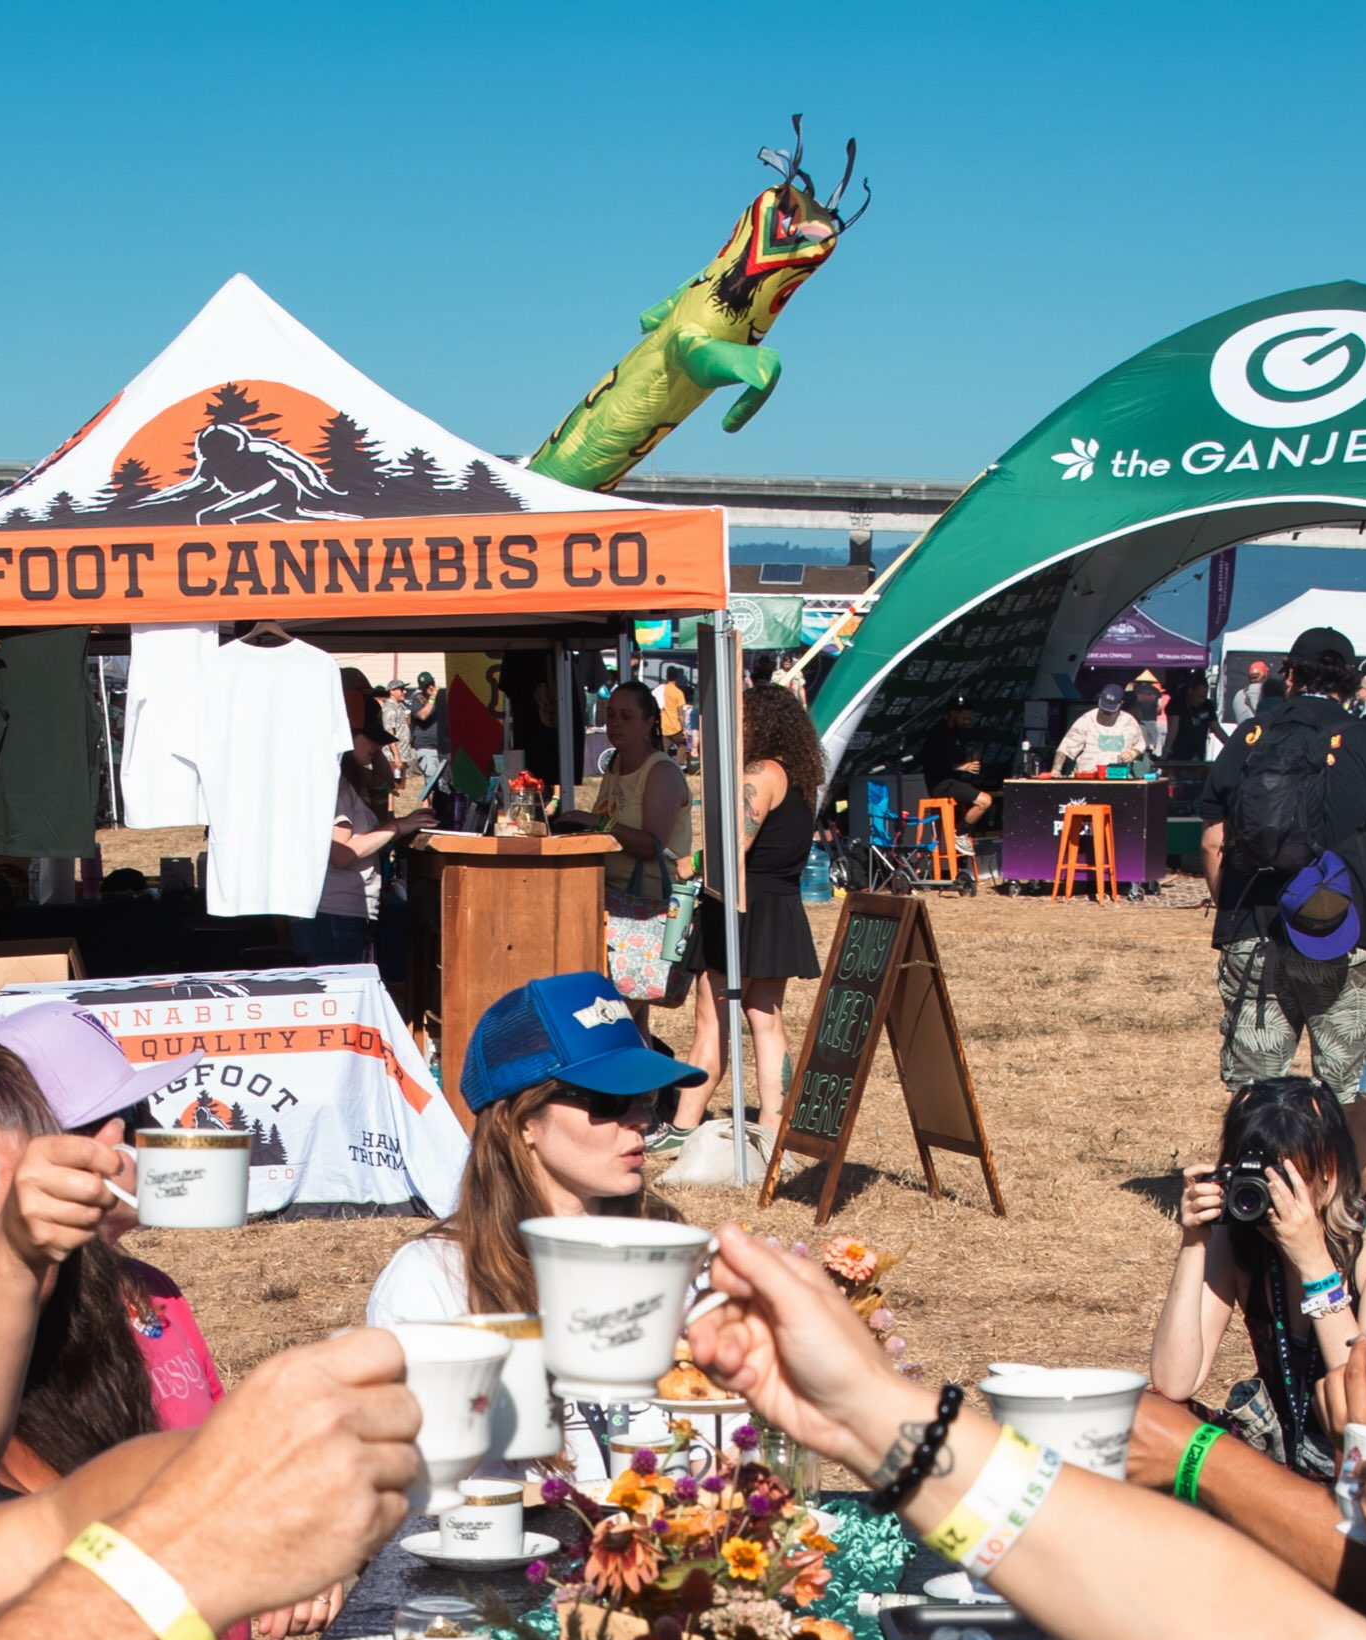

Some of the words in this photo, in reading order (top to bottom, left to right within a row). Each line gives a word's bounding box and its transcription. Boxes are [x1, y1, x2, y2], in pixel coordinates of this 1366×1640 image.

[1111, 448, 1170, 480] the
[176, 535, 539, 597] CANNABIS
[562, 531, 666, 590] CO.
[837, 914, 899, 983] BUY
[102, 1002, 263, 1030] NNABIS
[817, 989, 877, 1059] WEED
[141, 1031, 297, 1062] QUALITY
[150, 1062, 299, 1114] IGFOOT
[348, 1144, 408, 1172] TRIMM
[361, 1130, 402, 1157] HAN
[975, 1508, 1029, 1566] LOVE
